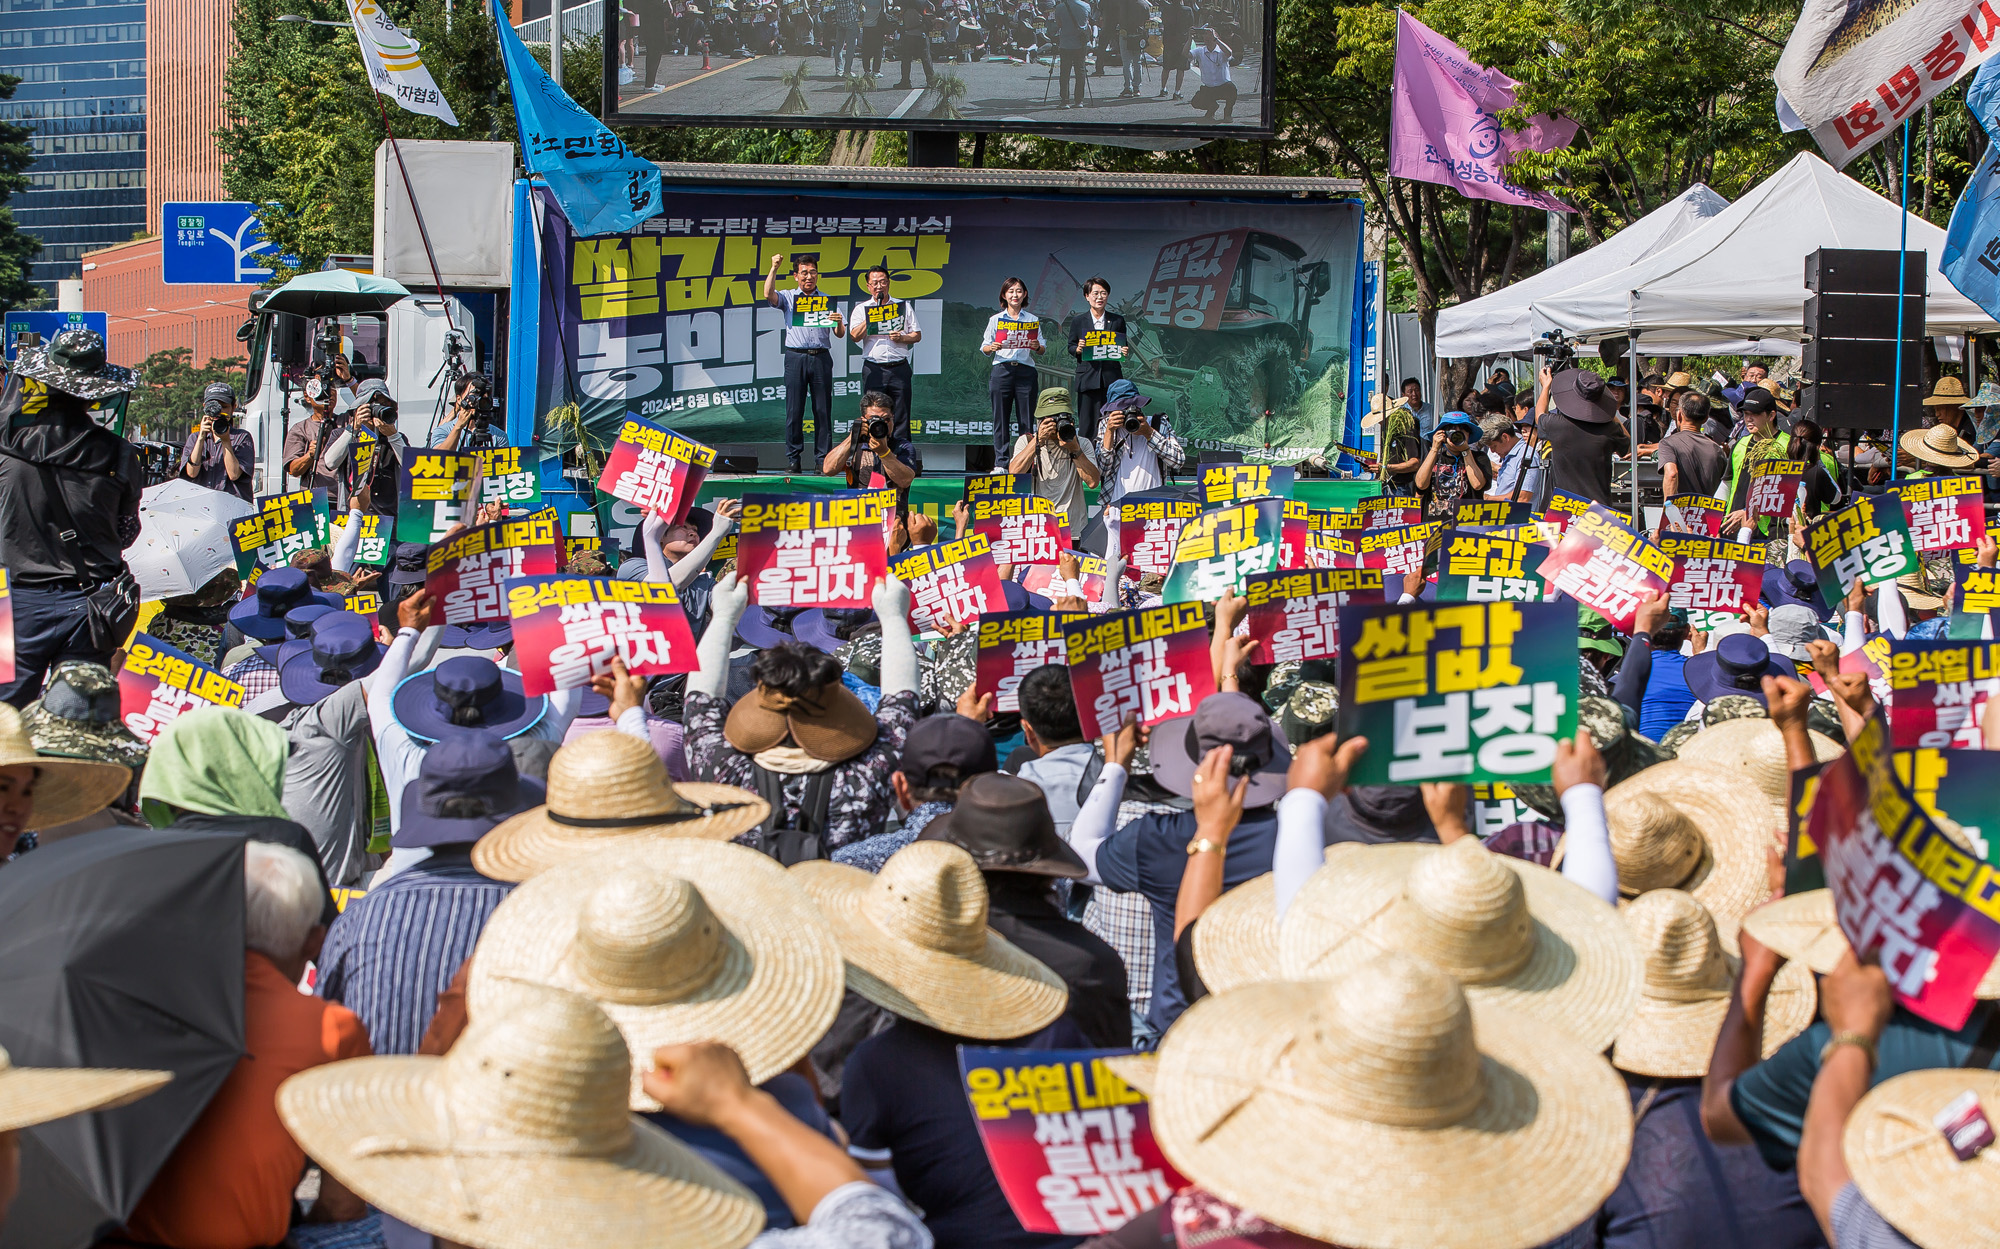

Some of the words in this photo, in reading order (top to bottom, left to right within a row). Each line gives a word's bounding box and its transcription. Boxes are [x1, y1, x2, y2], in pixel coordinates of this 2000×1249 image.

[177, 230, 204, 240] 통일로
[180, 218, 203, 227] 경찰청
[700, 219, 757, 235] 규탄!
[764, 217, 887, 234] 농민생존권
[893, 215, 952, 233] 사수!
[572, 234, 951, 320] 쌀값보장
[1154, 234, 1234, 282] 쌀값
[796, 296, 829, 312] 쌀값
[803, 311, 834, 326] 보장
[867, 302, 899, 323] 쌀값
[1144, 284, 1217, 329] 보장
[878, 315, 905, 335] 보장
[1019, 320, 1040, 331] 내리고
[1085, 331, 1117, 347] 쌀값
[1093, 344, 1122, 360] 보장
[641, 396, 685, 415] 2024년
[687, 393, 710, 409] 8월
[712, 388, 759, 406] 6일(화)
[833, 380, 861, 396] 울역
[619, 420, 664, 452] 윤석열
[662, 433, 697, 465] 내리고
[802, 420, 815, 434] 주
[833, 420, 853, 434] 농
[910, 419, 922, 434] 관
[472, 447, 521, 477] 쌀값
[636, 447, 678, 487] 쌀값
[1766, 461, 1805, 476] 내리고
[482, 471, 535, 503] 보장
[611, 470, 674, 514] 올리자
[1202, 465, 1272, 503] 쌀값
[1887, 481, 1930, 503] 석열
[1931, 476, 1983, 499] 내리고
[741, 501, 811, 534] 윤석열
[814, 496, 882, 529] 내리고
[974, 499, 1022, 520] 윤석열
[1024, 497, 1057, 516] 내리고
[1121, 501, 1165, 523] 윤석열
[1322, 513, 1364, 530] 내리고
[1357, 497, 1387, 514] 윤석열
[1388, 497, 1421, 509] 내리고
[1371, 507, 1404, 527] 쌀값
[1550, 494, 1591, 517] 윤석열
[1691, 496, 1727, 512] 내리고
[1910, 496, 1959, 527] 쌀값
[234, 507, 297, 553] 쌀값
[999, 513, 1047, 540] 쌀값
[1176, 503, 1260, 563] 쌀값
[1316, 534, 1356, 556] 내리고
[1360, 531, 1401, 554] 윤석열
[1402, 520, 1443, 544] 내리고
[1810, 500, 1881, 570] 쌀값
[427, 522, 486, 574] 윤석열
[488, 518, 554, 550] 내리고
[711, 535, 738, 561] 쌀
[774, 526, 853, 569] 쌀값
[932, 535, 992, 569] 내리고
[990, 537, 1058, 565] 올리자
[1132, 541, 1176, 567] 올리
[1383, 540, 1425, 568] 쌀값
[1448, 536, 1527, 579] 쌀값
[1575, 511, 1636, 556] 윤석열
[1627, 539, 1675, 584] 내리고
[1659, 538, 1711, 559] 윤석열
[1712, 541, 1768, 566] 내리고
[1832, 529, 1908, 596] 보장
[455, 547, 526, 592] 쌀값
[756, 562, 869, 607] 올리자
[909, 563, 971, 608] 쌀값
[1247, 573, 1313, 607] 윤석열
[1316, 568, 1384, 592] 내리고
[1592, 545, 1649, 594] 쌀값
[1683, 558, 1737, 584] 쌀값
[443, 583, 509, 625] 올리
[508, 580, 593, 619] 윤석열
[594, 582, 680, 606] 내리고
[911, 584, 987, 635] 올리자
[1552, 562, 1640, 622] 올리자
[1668, 582, 1744, 608] 올리자
[1962, 571, 2000, 614] 쌀
[558, 600, 648, 645] 쌀값
[979, 615, 1044, 649] 윤석열
[1066, 618, 1126, 667] 윤석열
[1127, 601, 1207, 644] 내리고
[549, 629, 672, 691] 올리자
[1271, 623, 1341, 664] 올리
[1351, 601, 1525, 705] 쌀값
[124, 643, 195, 690] 윤석열
[190, 667, 246, 709] 내리고
[1098, 637, 1172, 694] 쌀값
[1892, 646, 1968, 690] 윤석열
[1094, 672, 1192, 736] 올리자
[1388, 681, 1566, 782] 보장
[1474, 799, 1549, 836] 보
[966, 1062, 1074, 1121] 윤석열
[1034, 1105, 1143, 1176] 쌀값
[1036, 1168, 1176, 1235] 올리자
